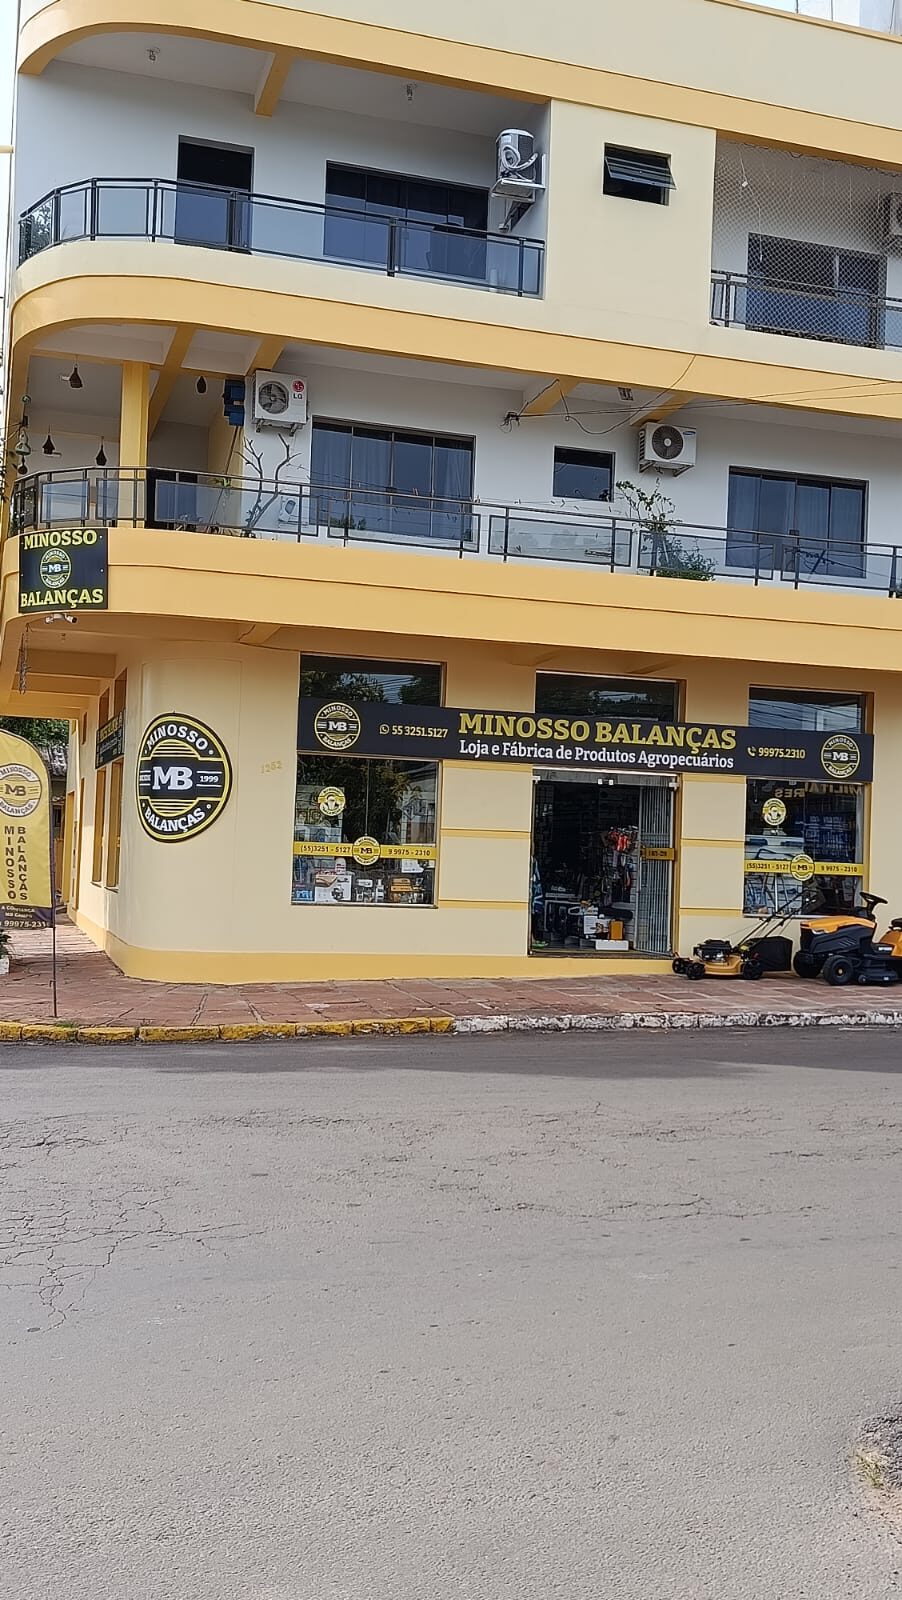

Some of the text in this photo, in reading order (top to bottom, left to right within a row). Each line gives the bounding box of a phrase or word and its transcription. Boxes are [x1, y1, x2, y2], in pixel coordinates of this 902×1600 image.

[23, 529, 97, 550] MINOSSO
[48, 563, 62, 573] MB
[20, 588, 104, 609] BALANÇAS
[328, 720, 347, 732] MB
[392, 725, 449, 738] 55 3251.5127
[458, 712, 737, 754] MINOSSO BALANÇAS
[146, 724, 209, 750] MINOSSO
[459, 739, 734, 769] Loja e Fábrica de Produtos Agropecuários
[758, 747, 806, 759] 99975.2310
[832, 751, 849, 761] MB
[152, 766, 193, 790] MB
[200, 775, 219, 783] 1999
[4, 783, 27, 797] MB
[144, 807, 206, 832] BALANÇAS
[4, 825, 17, 899] MINOSSO
[17, 826, 28, 900] BALANÇAS
